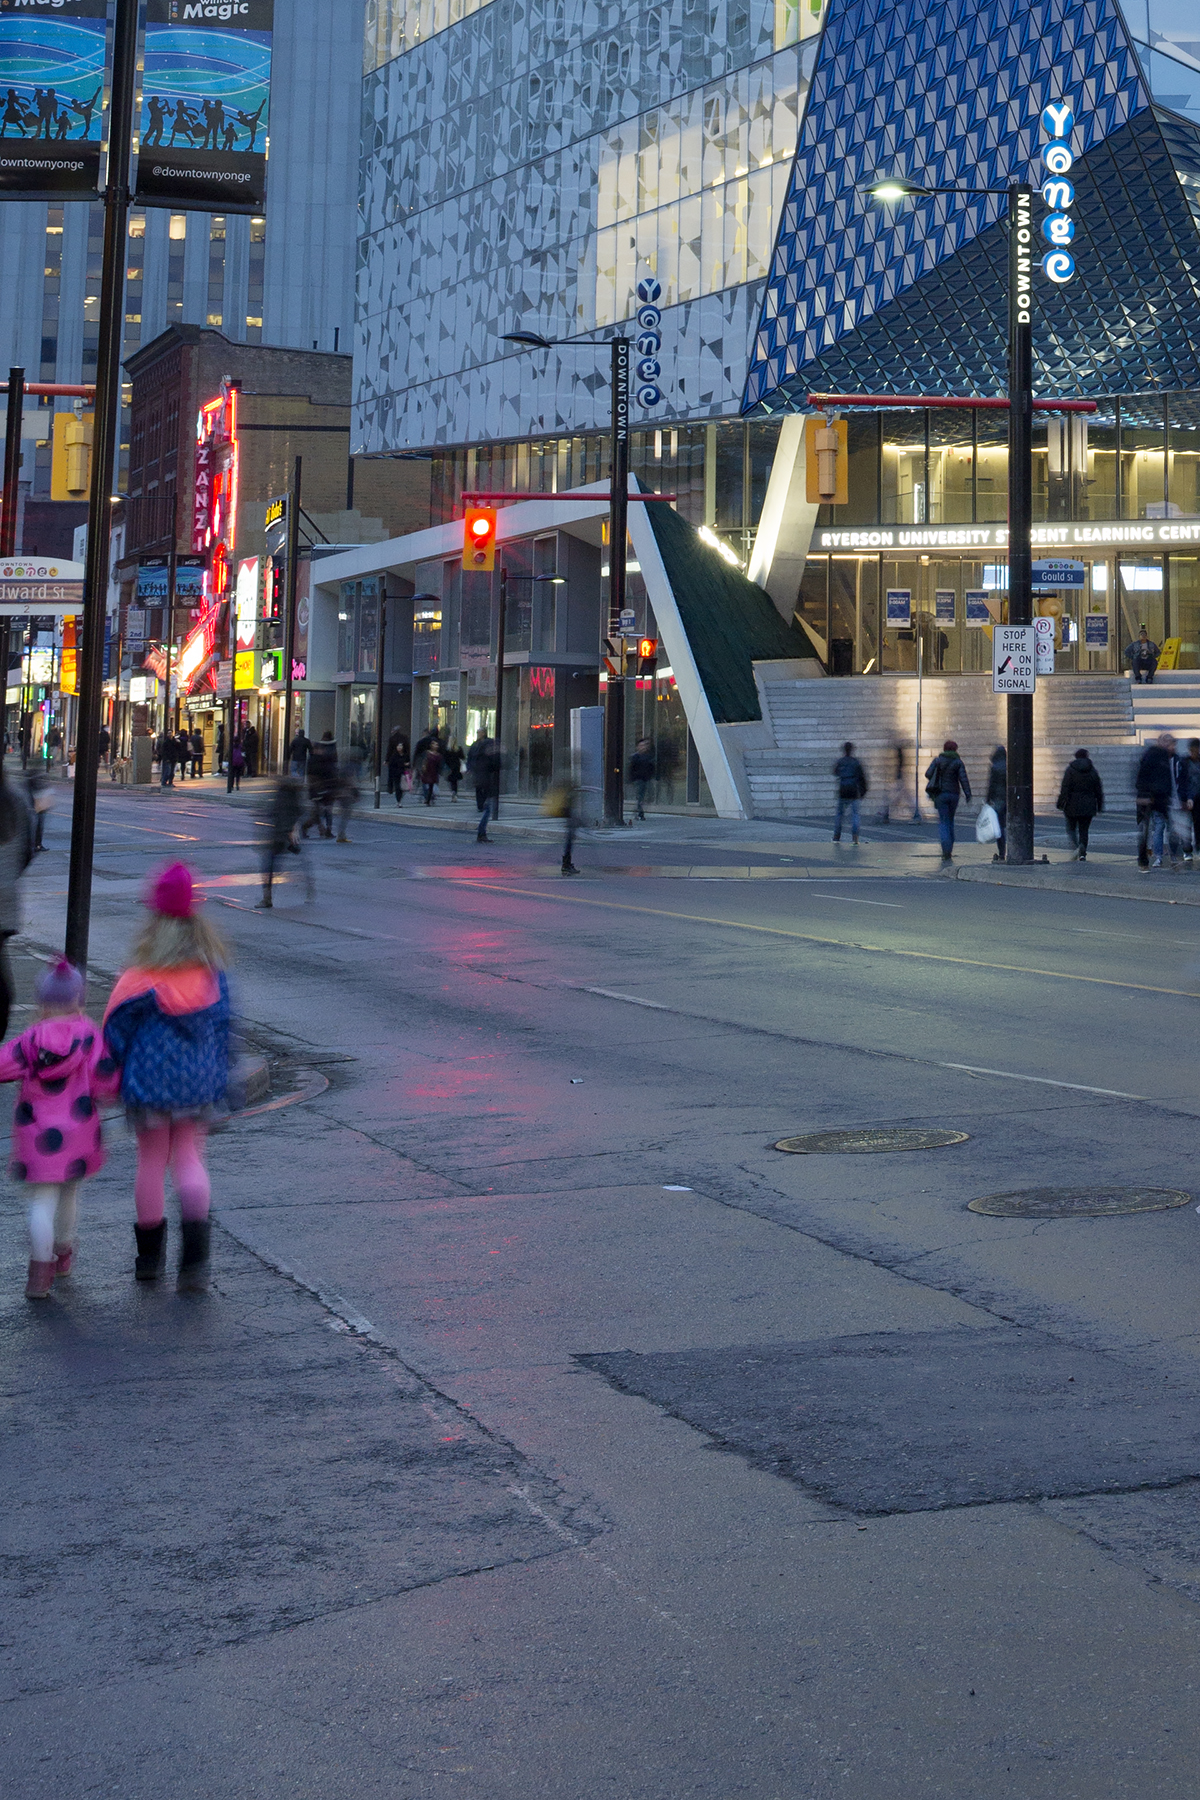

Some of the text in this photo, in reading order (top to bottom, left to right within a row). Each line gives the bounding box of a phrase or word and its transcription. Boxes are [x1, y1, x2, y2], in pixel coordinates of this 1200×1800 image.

[183, 3, 249, 20] Magic
[0, 157, 84, 172] owntownyonge
[152, 166, 251, 182] @downtownyonge
[1042, 104, 1074, 283] Yonge
[1018, 193, 1030, 324] DOWNTOWN
[637, 278, 661, 409] Yonge
[617, 345, 627, 439] DOWNTOWN
[821, 532, 893, 546] RYERSON
[898, 530, 990, 545] UNIVERSITY
[995, 528, 1068, 543] SDENT
[1074, 526, 1154, 542] LEARNING
[1042, 571, 1065, 581] Gould
[53, 586, 65, 599] St
[24, 605, 30, 613] 2
[1004, 630, 1026, 640] STOP
[1003, 643, 1026, 652] HERE
[1019, 655, 1031, 663] ON
[1013, 667, 1031, 676] RED
[998, 679, 1030, 688] SIGNAL
